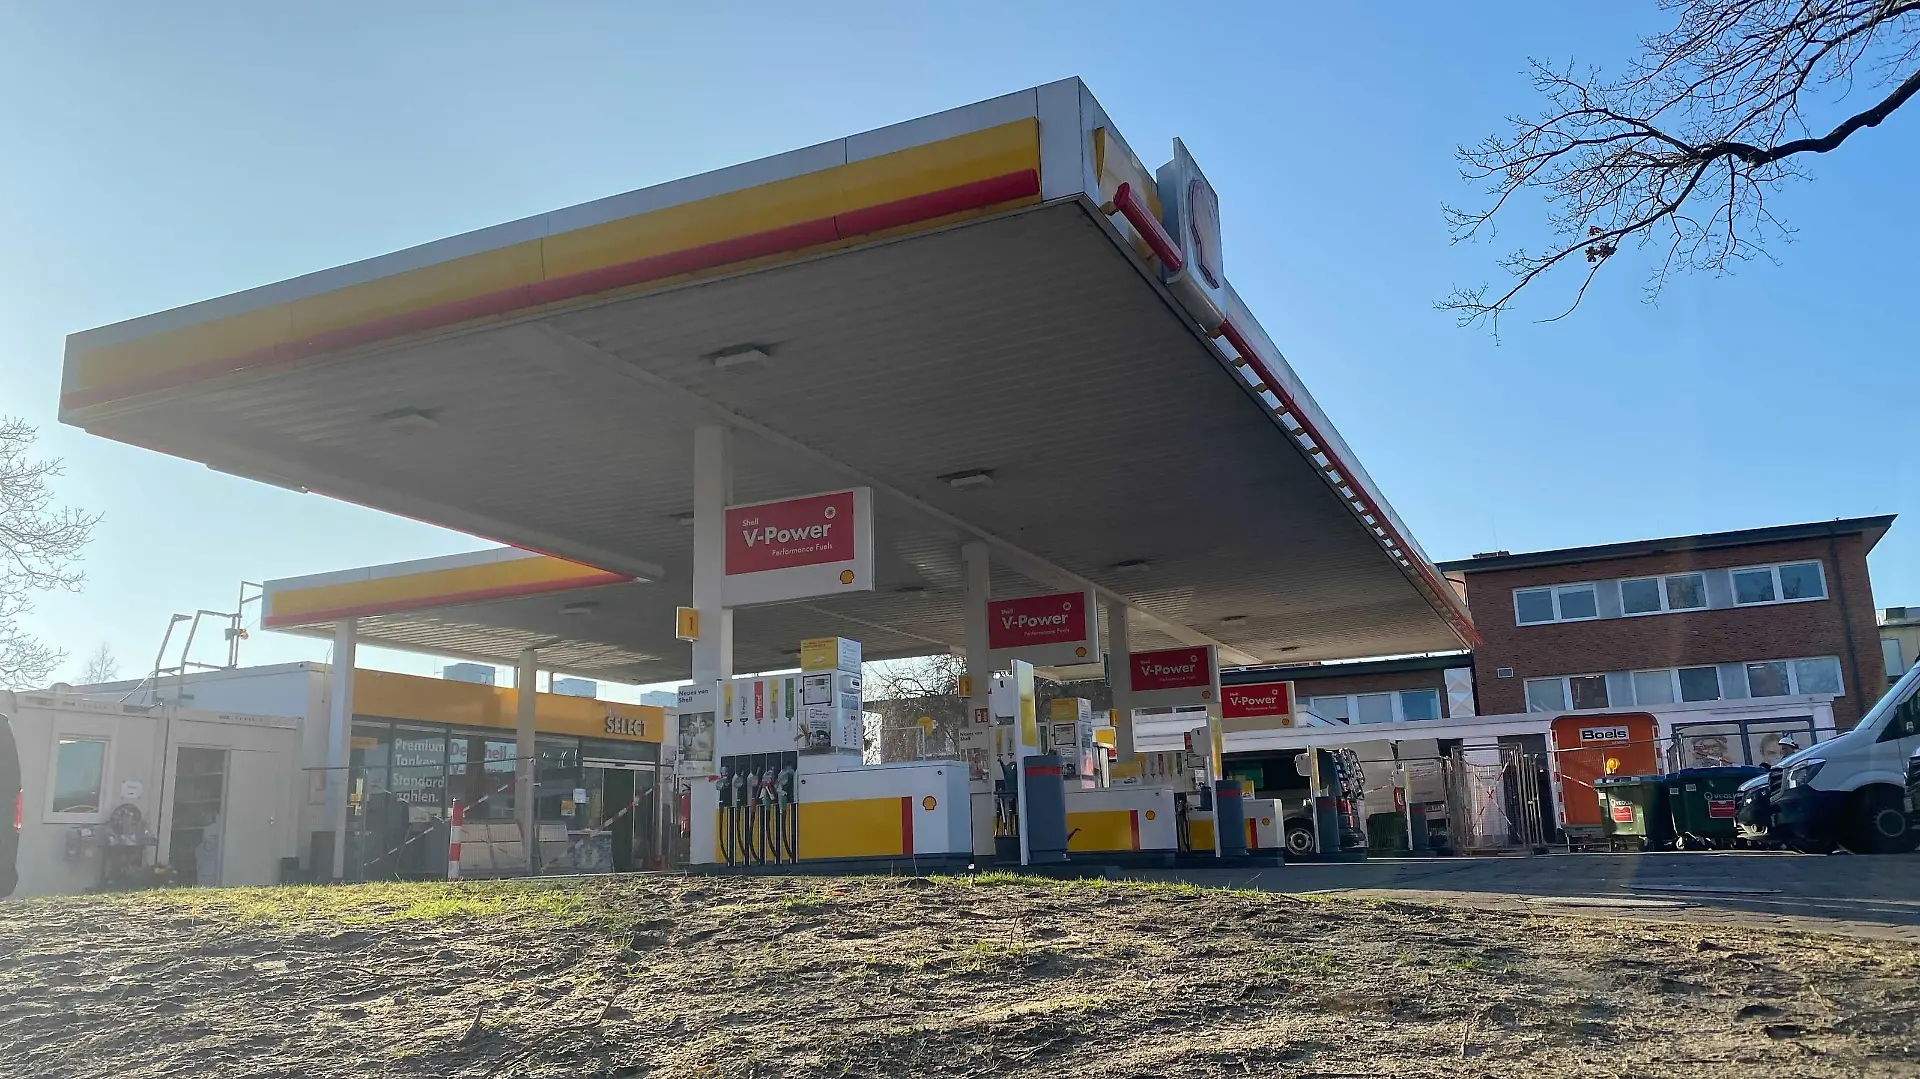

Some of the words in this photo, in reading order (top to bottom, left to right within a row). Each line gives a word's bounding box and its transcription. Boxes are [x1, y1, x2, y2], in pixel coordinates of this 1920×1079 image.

[742, 517, 759, 527] Shell
[742, 523, 832, 548] V-Power
[772, 546, 814, 557] Performance
[815, 541, 833, 551] Fuels
[1001, 614, 1069, 630] V-Power
[1141, 664, 1196, 677] V-Power
[678, 696, 693, 704] Shell
[1230, 696, 1277, 706] V-Power
[605, 716, 646, 736] SELECT
[1582, 728, 1627, 740] Boels
[395, 737, 445, 752] Premium
[485, 743, 507, 760] hell
[392, 772, 445, 788] Standard
[396, 789, 439, 803] zahlen.
